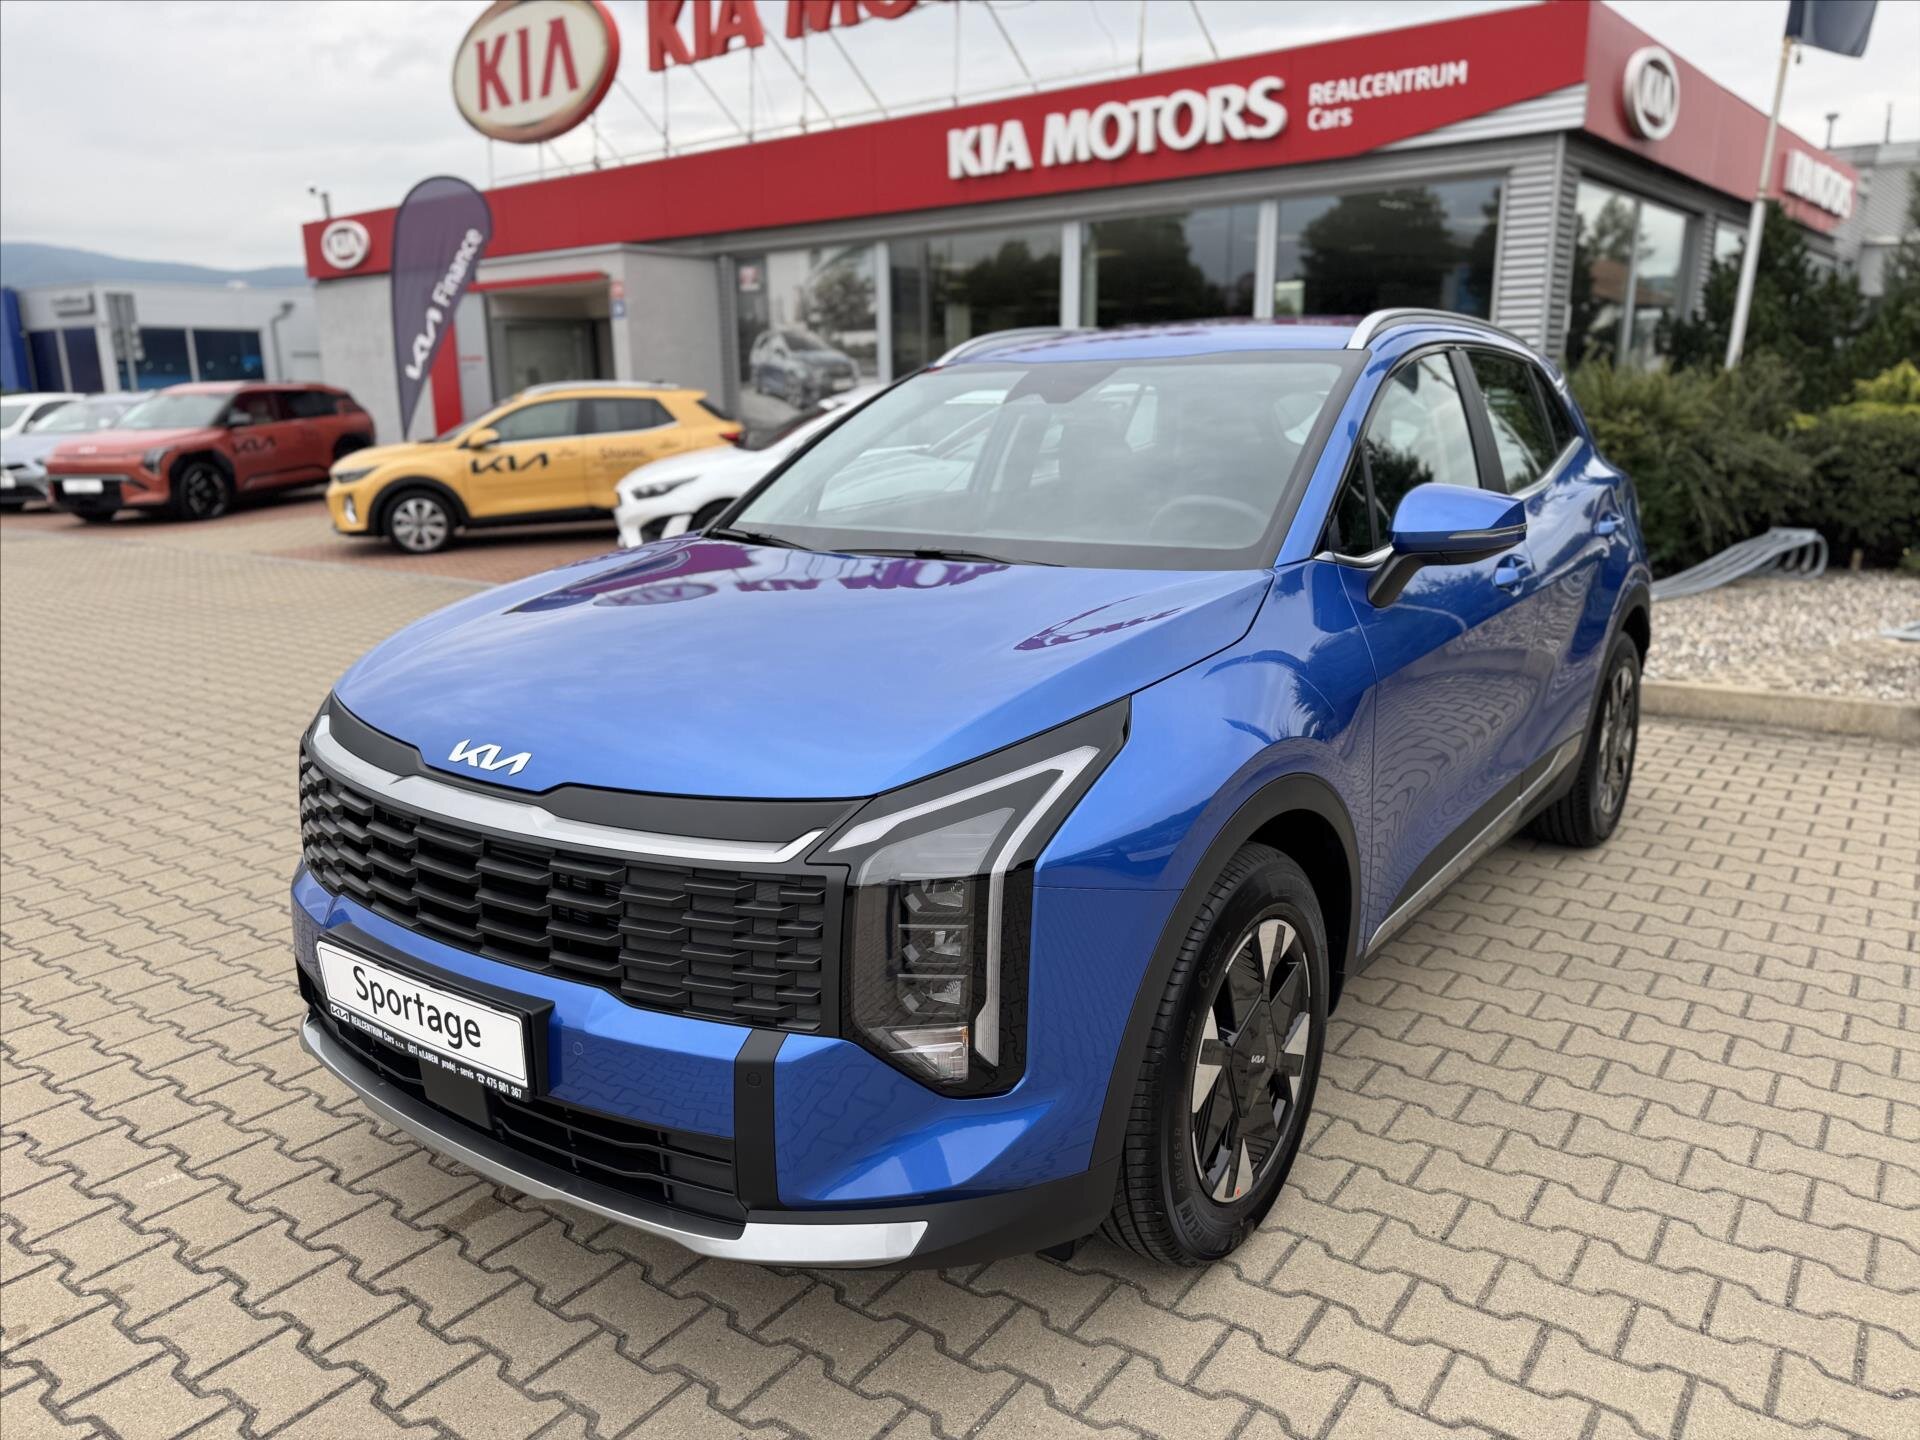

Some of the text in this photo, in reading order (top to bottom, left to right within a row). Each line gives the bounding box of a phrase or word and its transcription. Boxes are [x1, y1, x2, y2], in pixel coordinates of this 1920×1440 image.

[475, 16, 580, 113] KIA
[647, 0, 765, 72] KIA
[1307, 106, 1353, 131] Cars
[1308, 59, 1468, 107] REALCENTRUM
[947, 75, 1288, 180] KIA MOTORS
[405, 307, 443, 380] KIA
[432, 228, 482, 308] Finance
[470, 451, 549, 475] KIA
[448, 738, 532, 776] KIA
[352, 965, 482, 1050] Sportage
[350, 1014, 383, 1039] REALCENTRUM
[383, 1030, 395, 1045] Cars
[486, 1076, 498, 1090] 475
[498, 1081, 510, 1095] 601
[510, 1086, 522, 1099] 367
